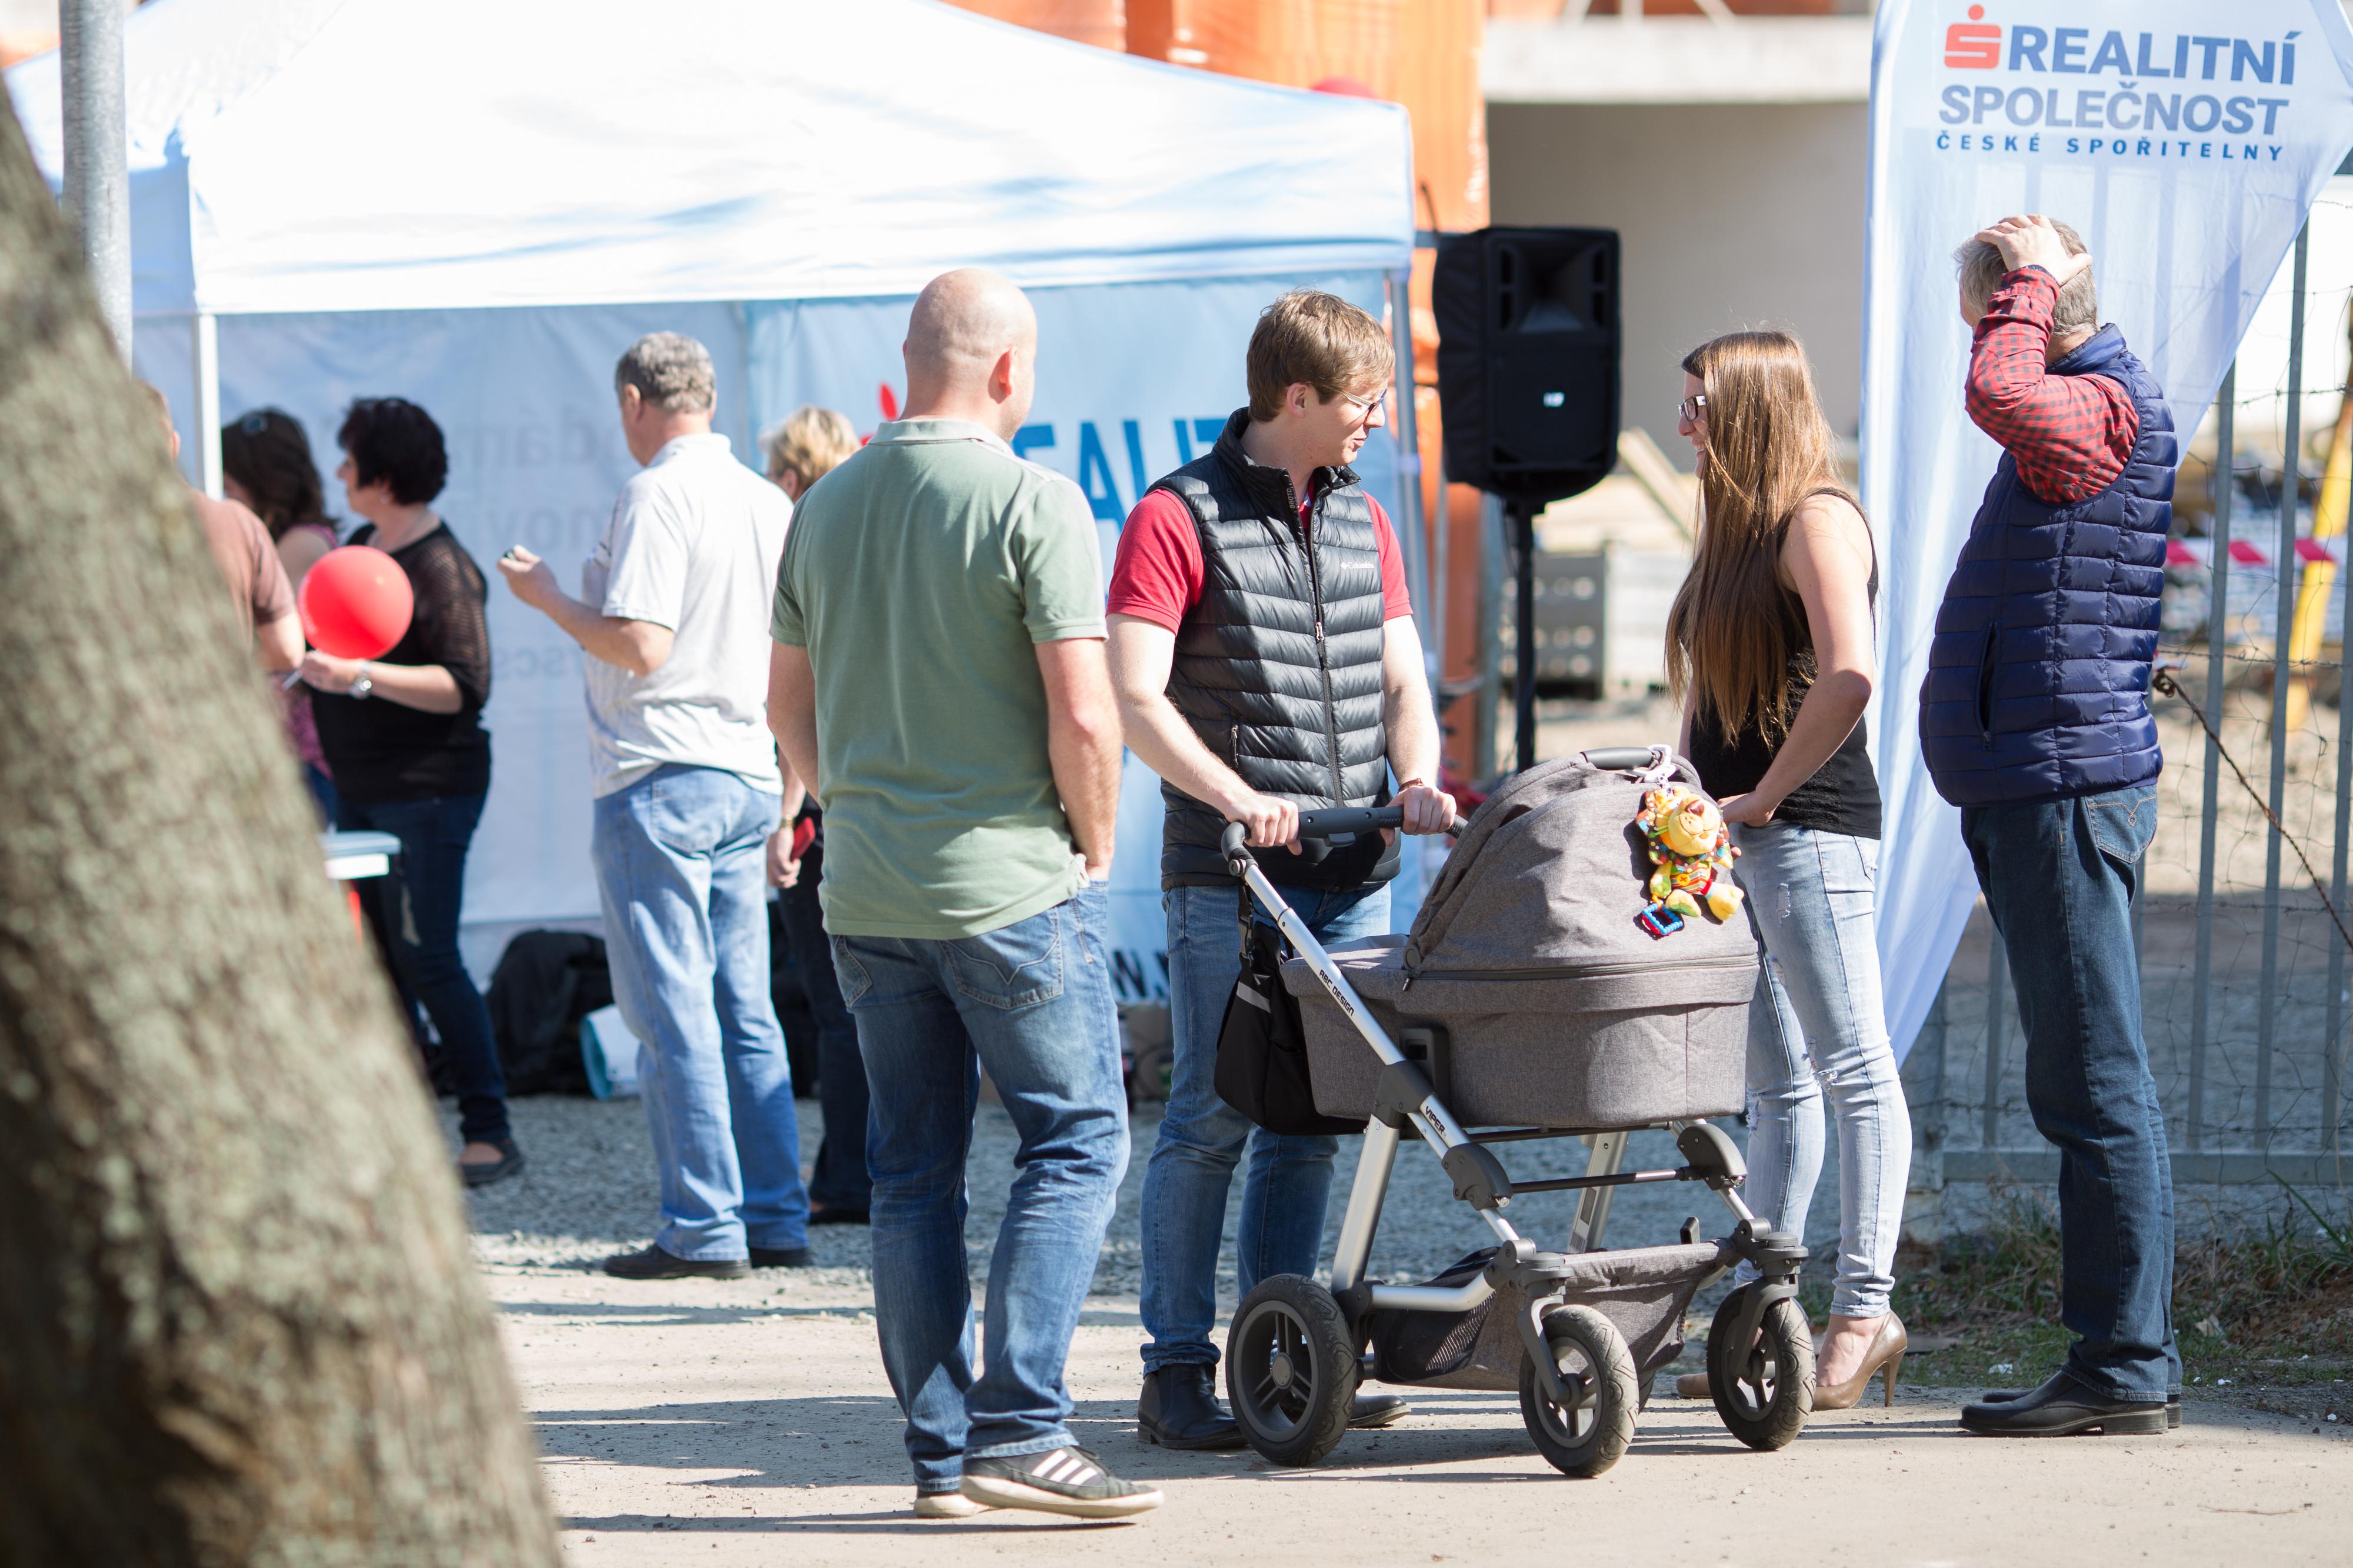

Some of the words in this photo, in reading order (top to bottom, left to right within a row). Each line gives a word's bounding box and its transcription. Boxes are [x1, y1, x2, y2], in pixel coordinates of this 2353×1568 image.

[2008, 25, 2302, 86] REALITNÍ
[1939, 81, 2289, 135] SPOLEČNOST
[1937, 131, 2040, 152] ČESKÉ
[2067, 137, 2283, 161] SPOŘITELNY
[1319, 969, 1333, 989] ABC
[1332, 985, 1355, 1017] DESIGN
[1425, 1105, 1445, 1135] VIPER
